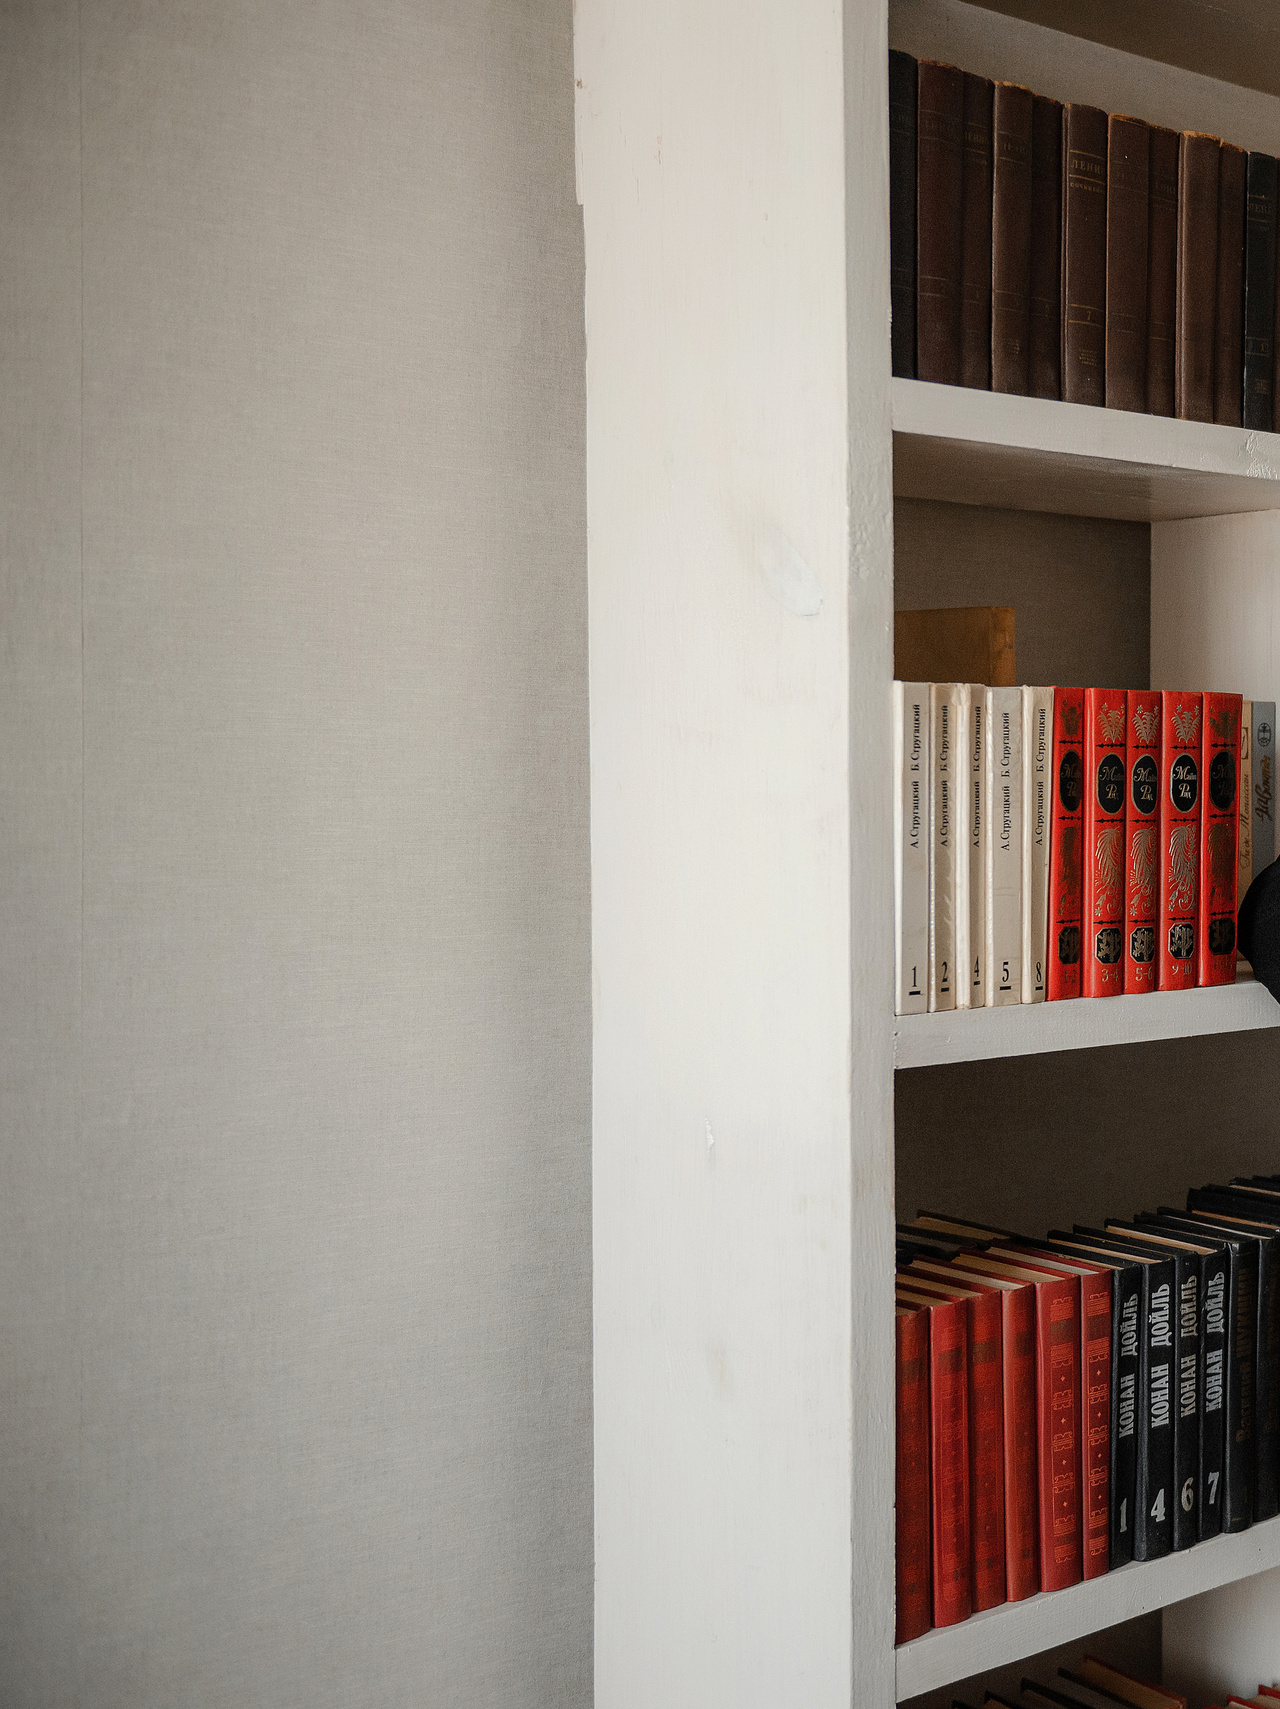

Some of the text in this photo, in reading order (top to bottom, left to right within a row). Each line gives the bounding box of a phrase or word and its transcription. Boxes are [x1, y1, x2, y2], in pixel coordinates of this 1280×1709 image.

[1070, 159, 1103, 175] ЛЕНИ
[911, 704, 922, 761] Стругацкий
[940, 705, 950, 761] Стругацкий
[973, 706, 982, 762] Стругацкий
[1001, 712, 1012, 767] Стругацкий
[1036, 708, 1046, 763] Стругацкий
[912, 965, 918, 988] 1
[941, 961, 948, 983] 2
[974, 956, 980, 978] 4
[1002, 961, 1010, 983] 5
[1036, 961, 1042, 983] 8
[1101, 968, 1119, 983] 3-4
[1149, 1283, 1172, 1429] КОНАН ДОЙЛЬ
[1180, 1275, 1198, 1418] КОНАН ДОЙЛЬ
[1204, 1271, 1225, 1413] КОНАН ДОЙЛЬ
[1118, 1293, 1139, 1439] КОНАН ДОЙЛЬ
[1150, 1488, 1166, 1523] 4
[1181, 1477, 1194, 1512] 6
[1207, 1471, 1220, 1505] 7
[1119, 1497, 1128, 1533] 1
